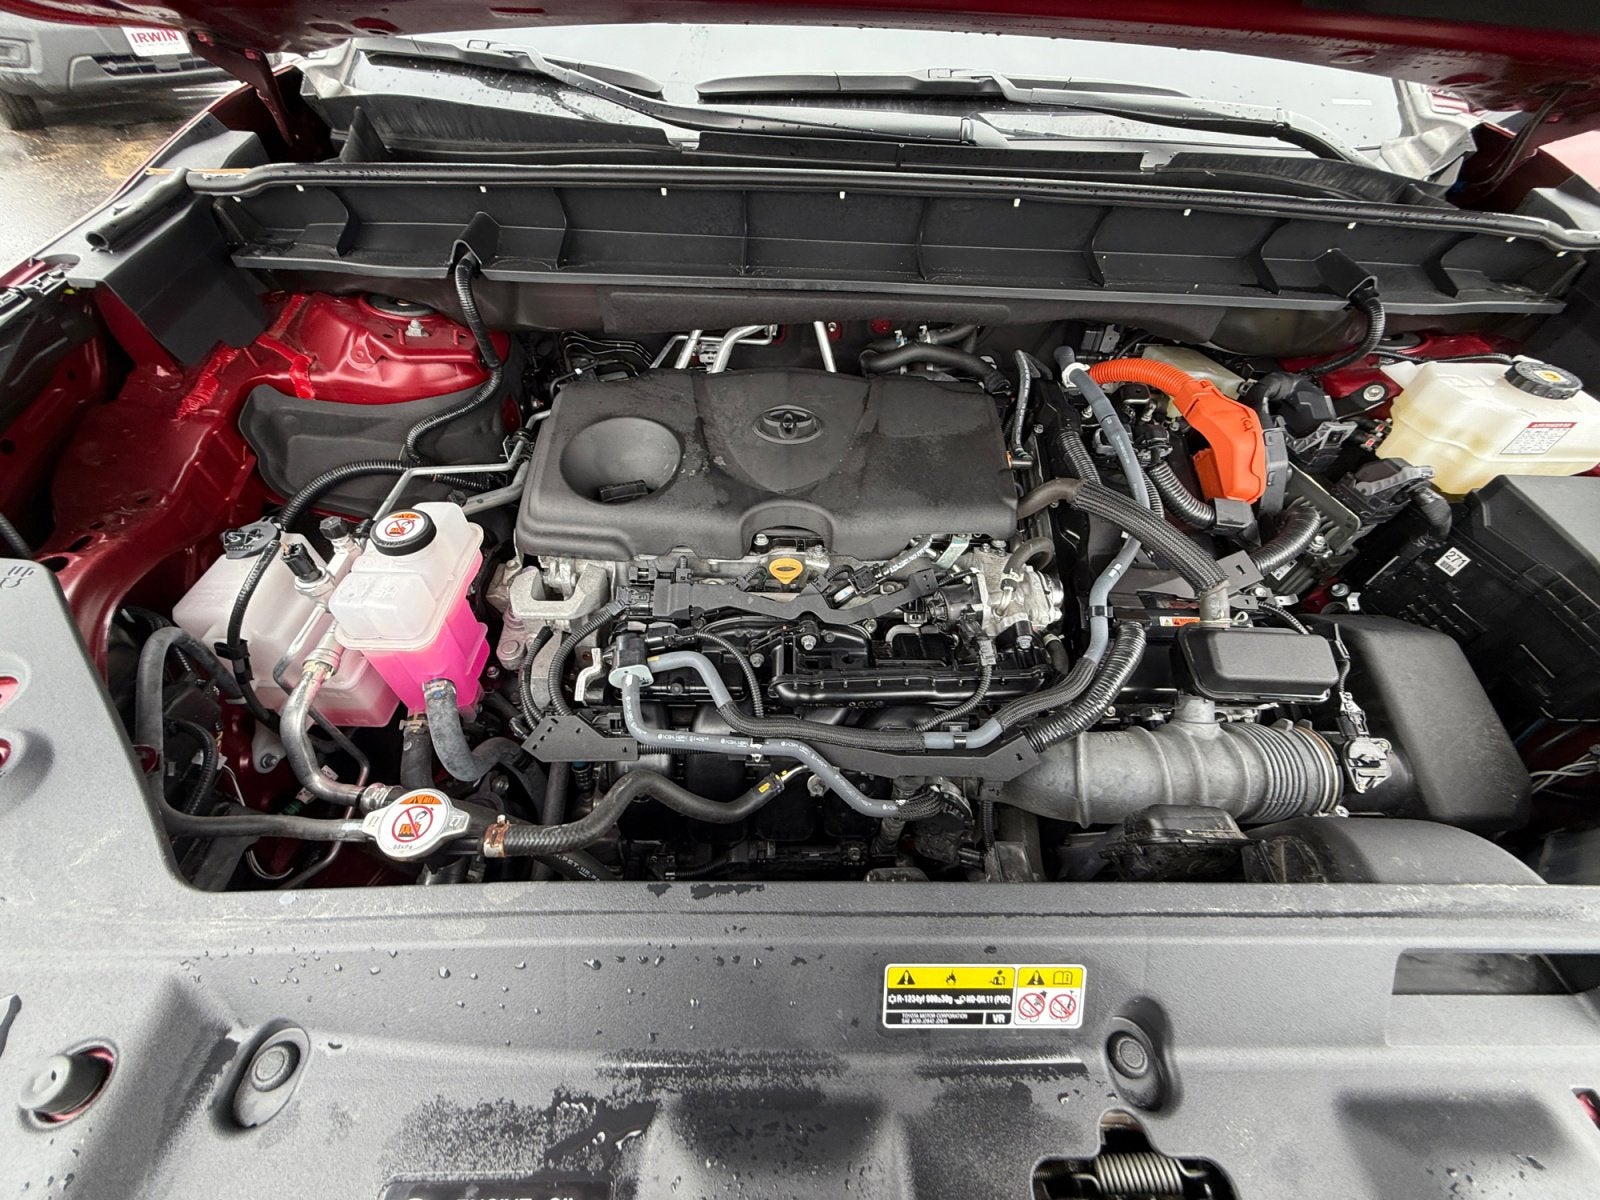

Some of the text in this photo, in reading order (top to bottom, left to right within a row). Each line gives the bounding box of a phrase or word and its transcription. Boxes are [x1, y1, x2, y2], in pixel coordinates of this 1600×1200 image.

[131, 30, 179, 43] IRWIN
[1444, 550, 1467, 568] 271
[992, 1013, 1005, 1023] VR
